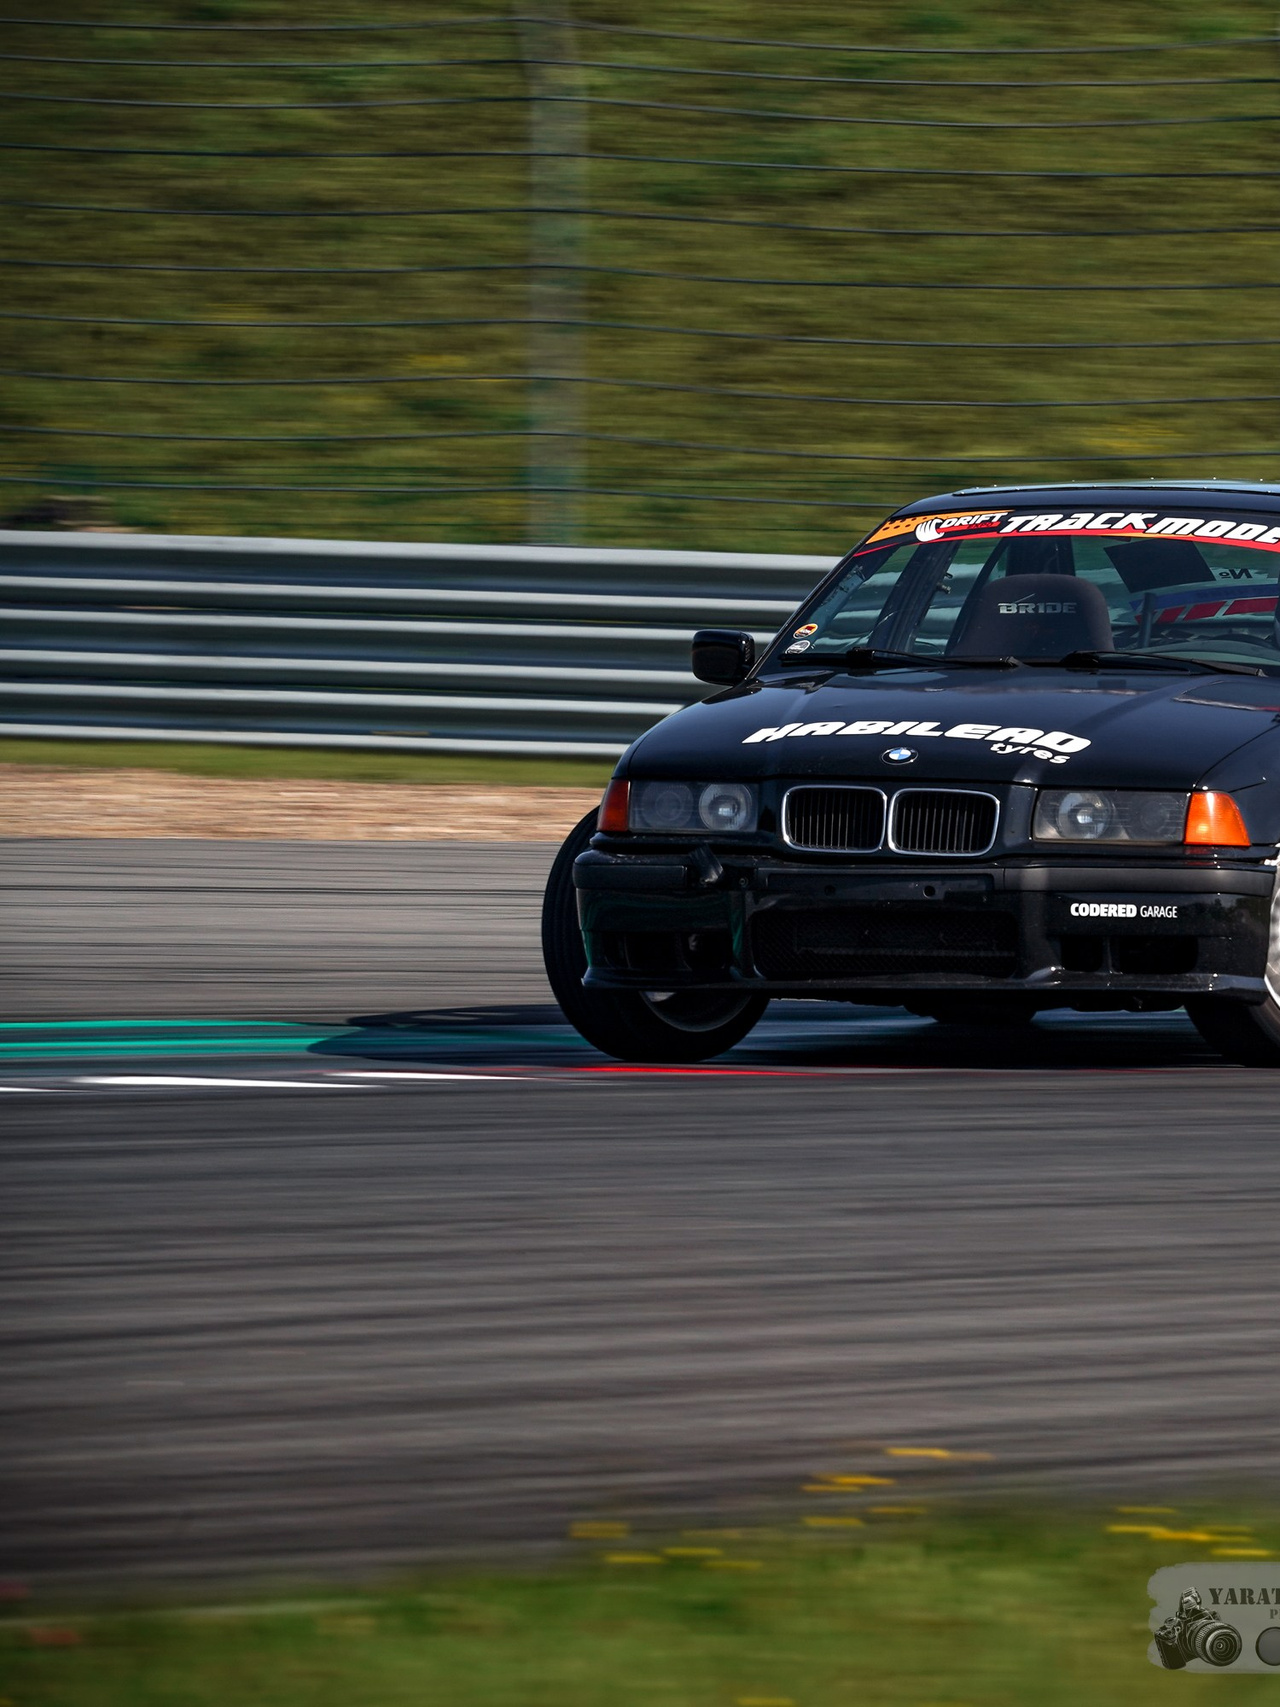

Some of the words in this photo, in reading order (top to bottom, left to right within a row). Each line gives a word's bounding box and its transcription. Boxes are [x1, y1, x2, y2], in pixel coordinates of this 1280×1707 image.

[940, 512, 1008, 529] DRIFT
[998, 602, 1077, 614] BRIDE
[741, 720, 1092, 753] HABILEAD
[989, 742, 1071, 764] tyres
[1070, 903, 1137, 918] CODERED
[1140, 905, 1178, 919] GARAGE
